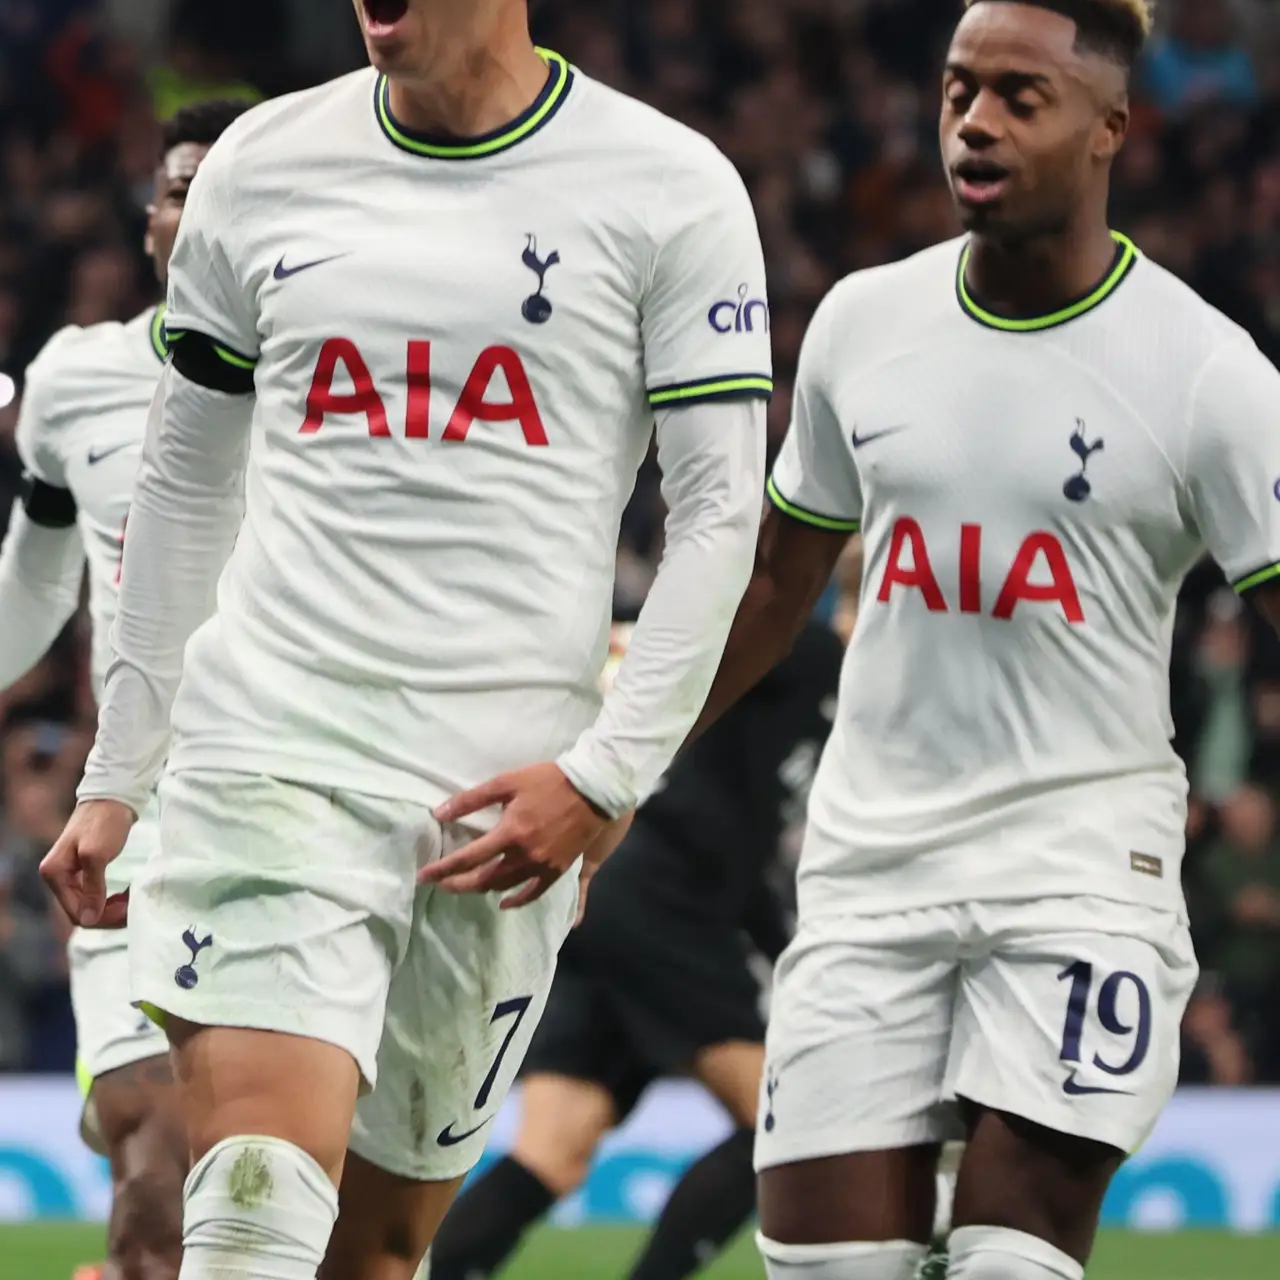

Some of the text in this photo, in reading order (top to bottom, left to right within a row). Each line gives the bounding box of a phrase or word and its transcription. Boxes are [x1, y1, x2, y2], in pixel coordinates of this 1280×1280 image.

[298, 337, 549, 446] AIA
[877, 516, 1085, 624] AIA
[473, 994, 534, 1110] 7
[1057, 961, 1152, 1076] 19
